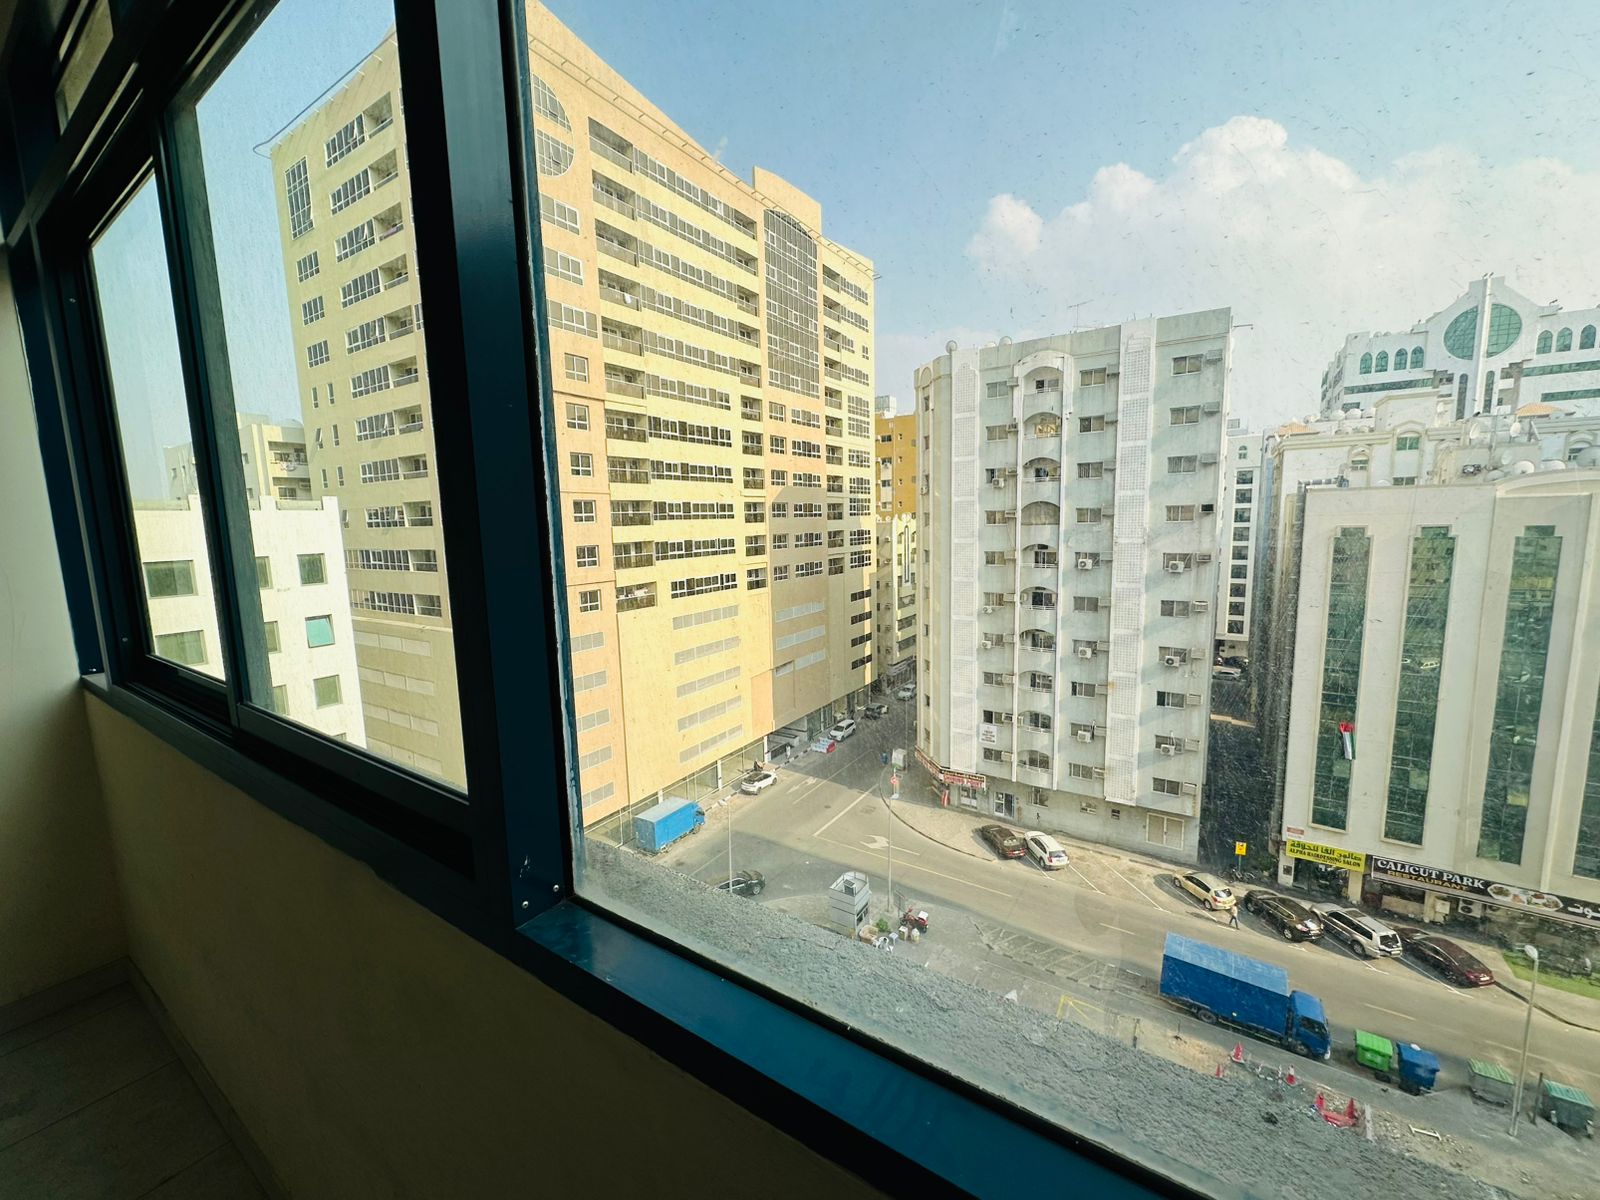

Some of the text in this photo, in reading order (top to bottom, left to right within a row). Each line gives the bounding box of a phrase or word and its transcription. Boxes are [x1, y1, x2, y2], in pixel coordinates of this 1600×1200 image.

[1343, 858, 1361, 867] SALON
[1377, 859, 1486, 889] CALICUT PARK
[1387, 870, 1468, 891] RESTAURANT
